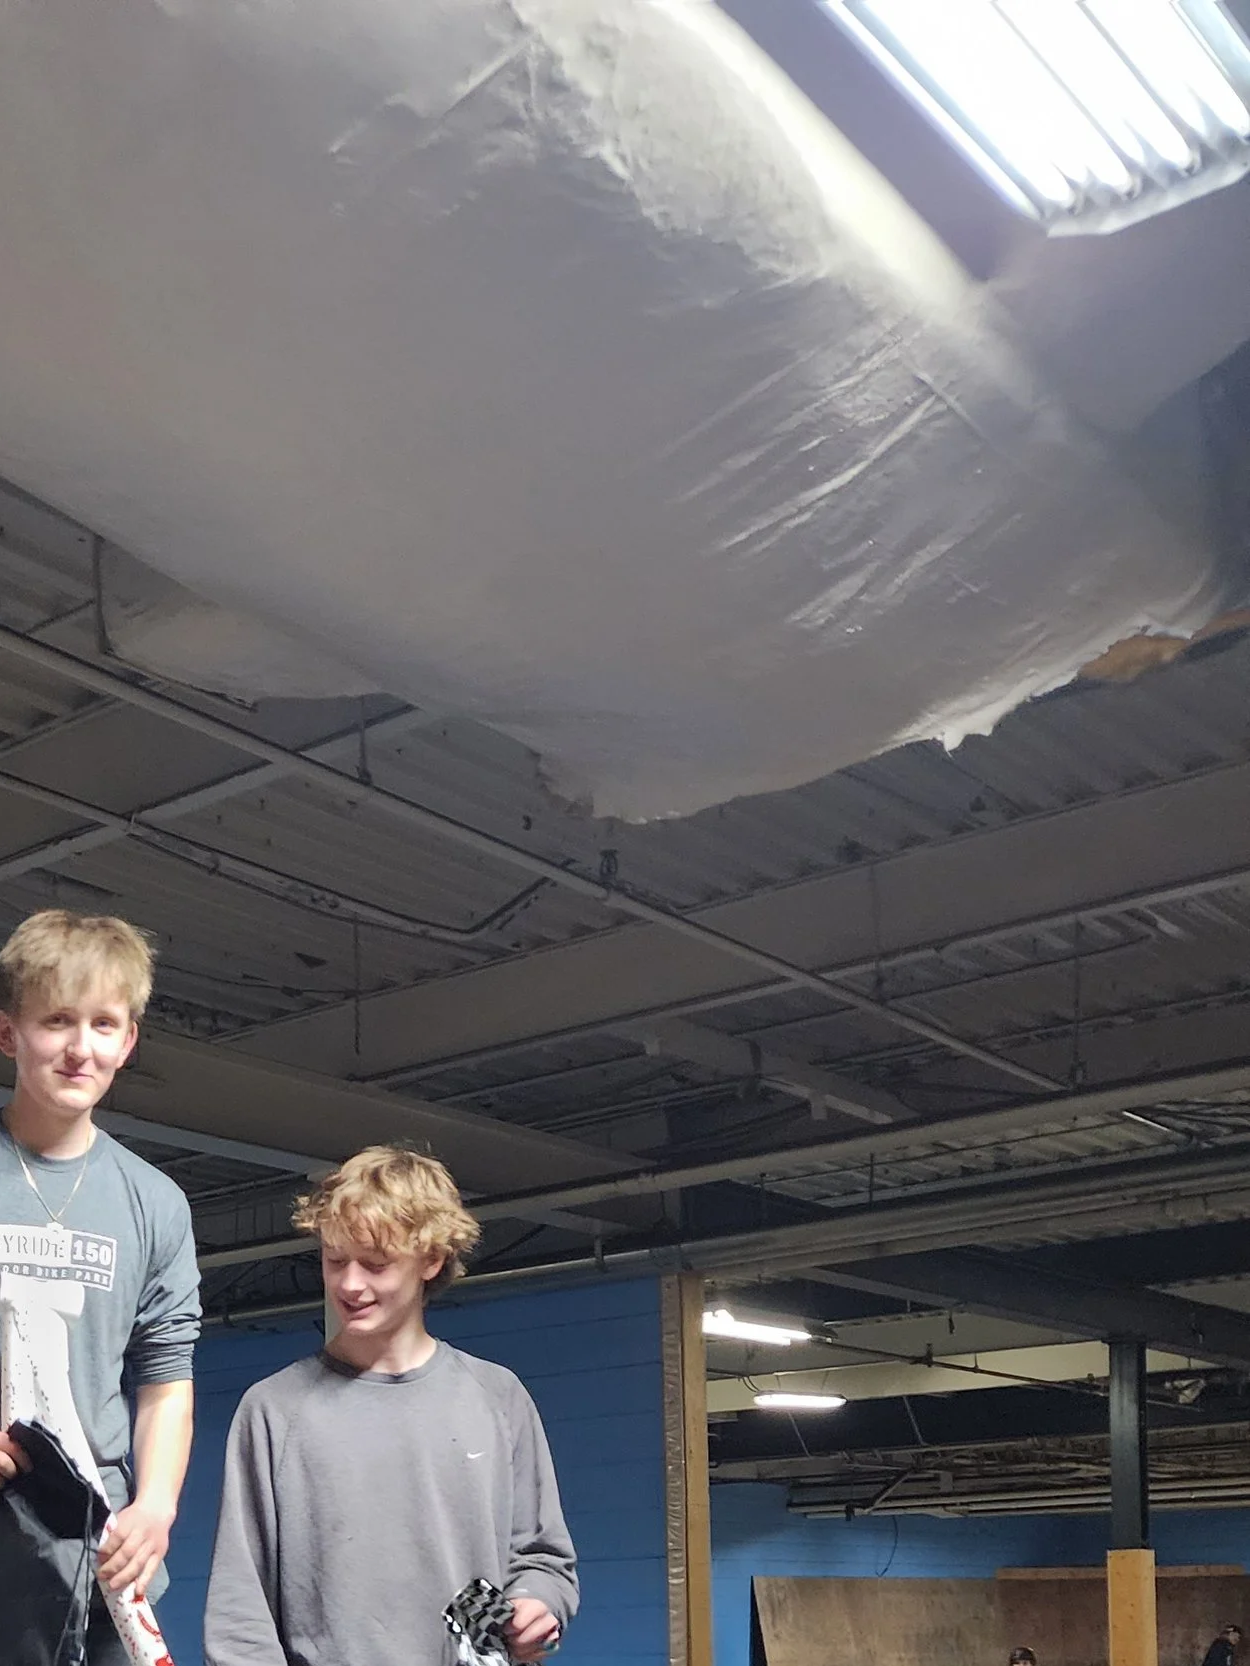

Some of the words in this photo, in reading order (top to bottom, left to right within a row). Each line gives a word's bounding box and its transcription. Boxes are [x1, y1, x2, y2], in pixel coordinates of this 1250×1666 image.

[72, 1238, 113, 1267] 150
[35, 1266, 68, 1279] BIKE
[75, 1269, 111, 1287] PARK
